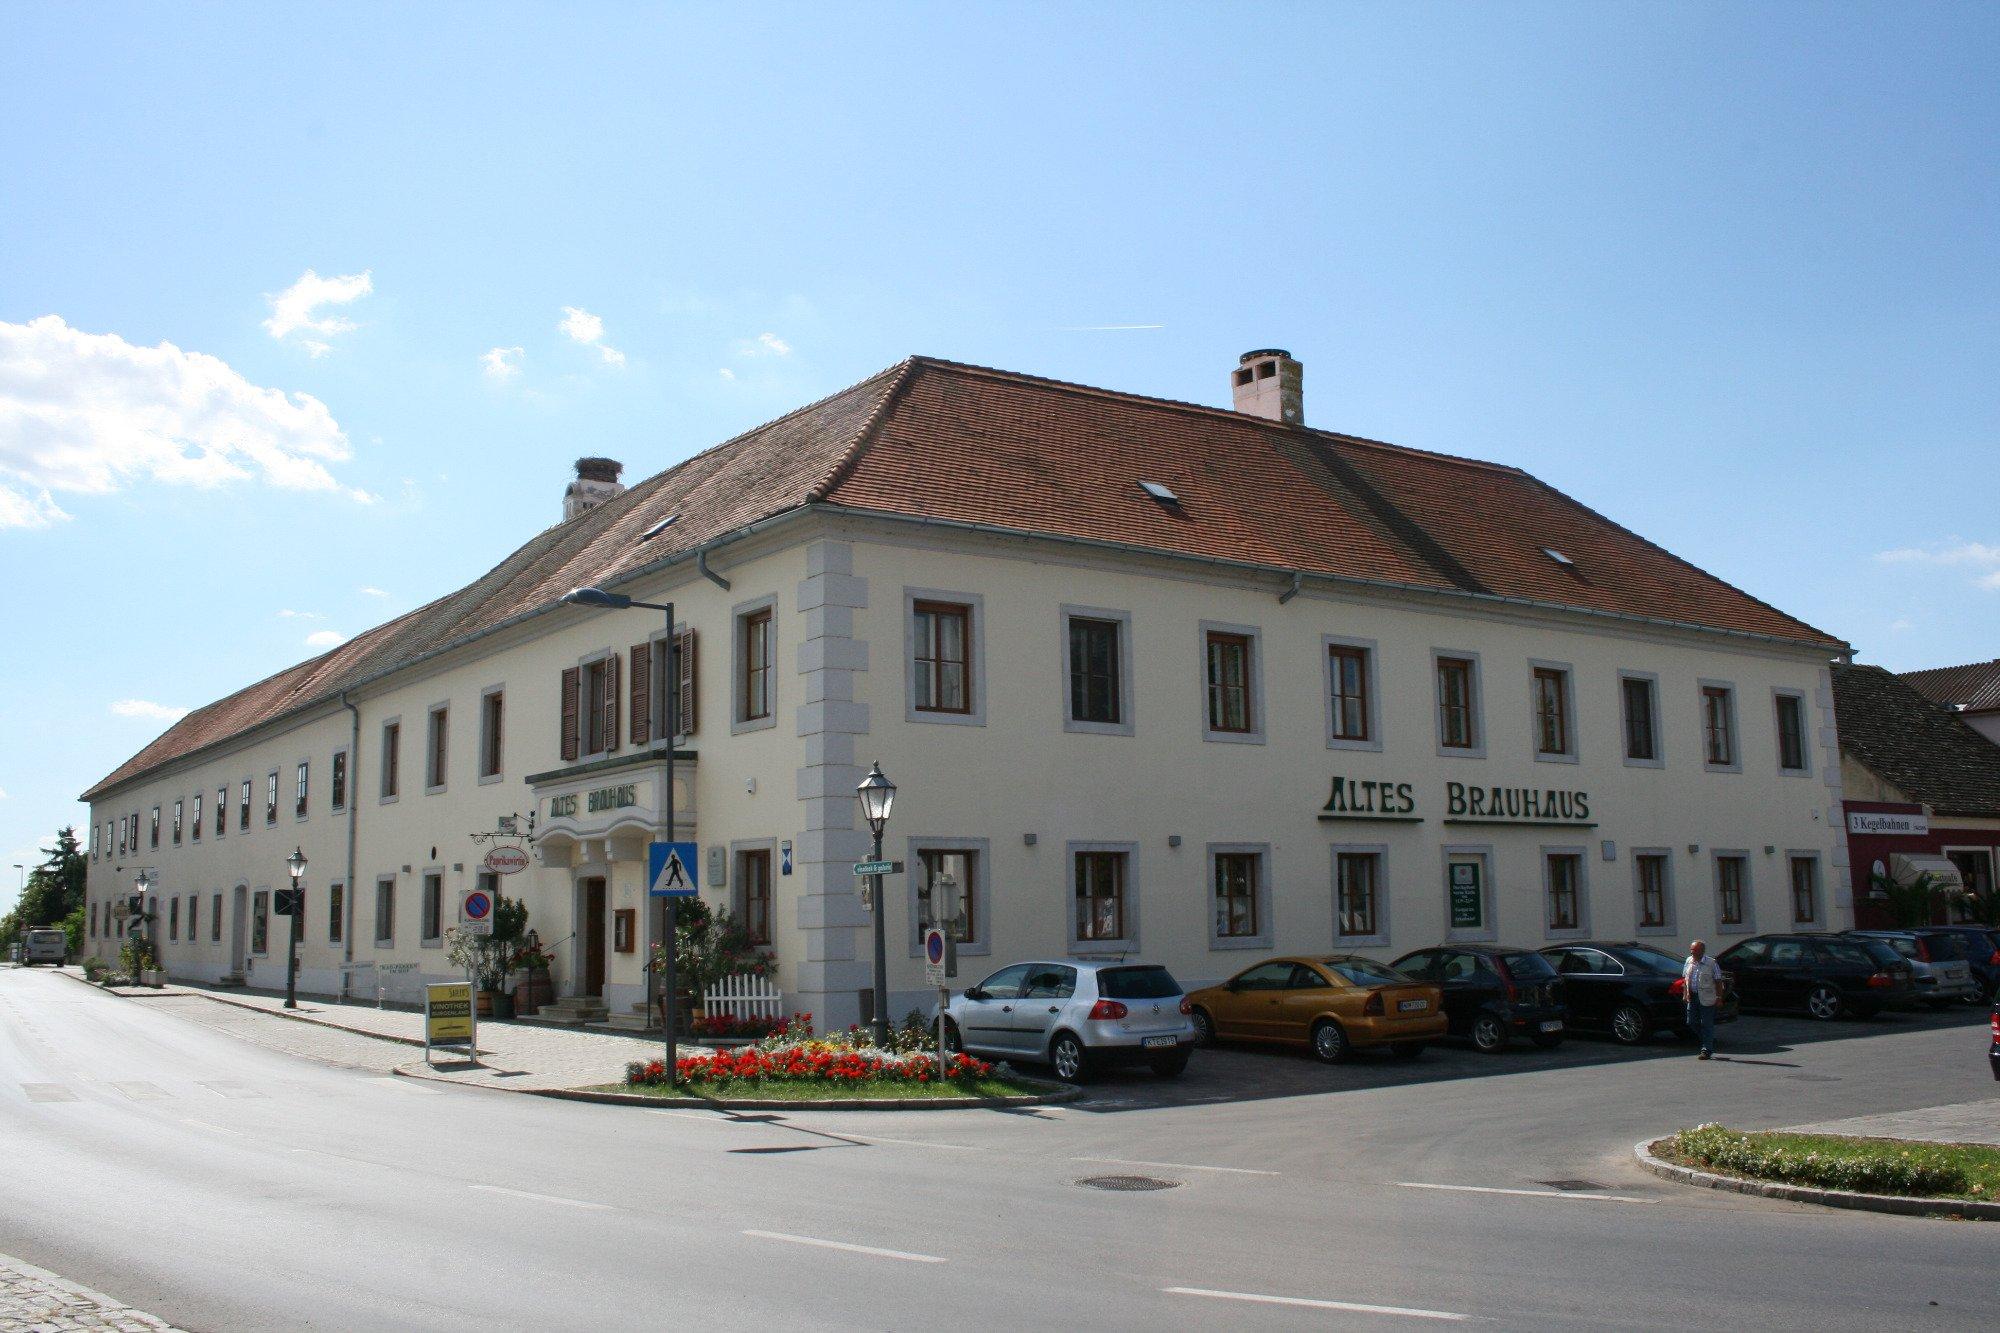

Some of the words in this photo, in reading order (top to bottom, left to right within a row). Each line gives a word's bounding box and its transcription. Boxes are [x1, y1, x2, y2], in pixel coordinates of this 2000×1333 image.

[550, 793, 578, 818] ALTES
[588, 784, 636, 813] BRAUHAUS
[1322, 776, 1415, 814] ALTES
[1446, 781, 1590, 820] BRAUHAUS
[1853, 816, 1859, 830] 3
[1860, 816, 1910, 831] Kegelbahnen
[432, 1002, 470, 1010] VINOTHEK
